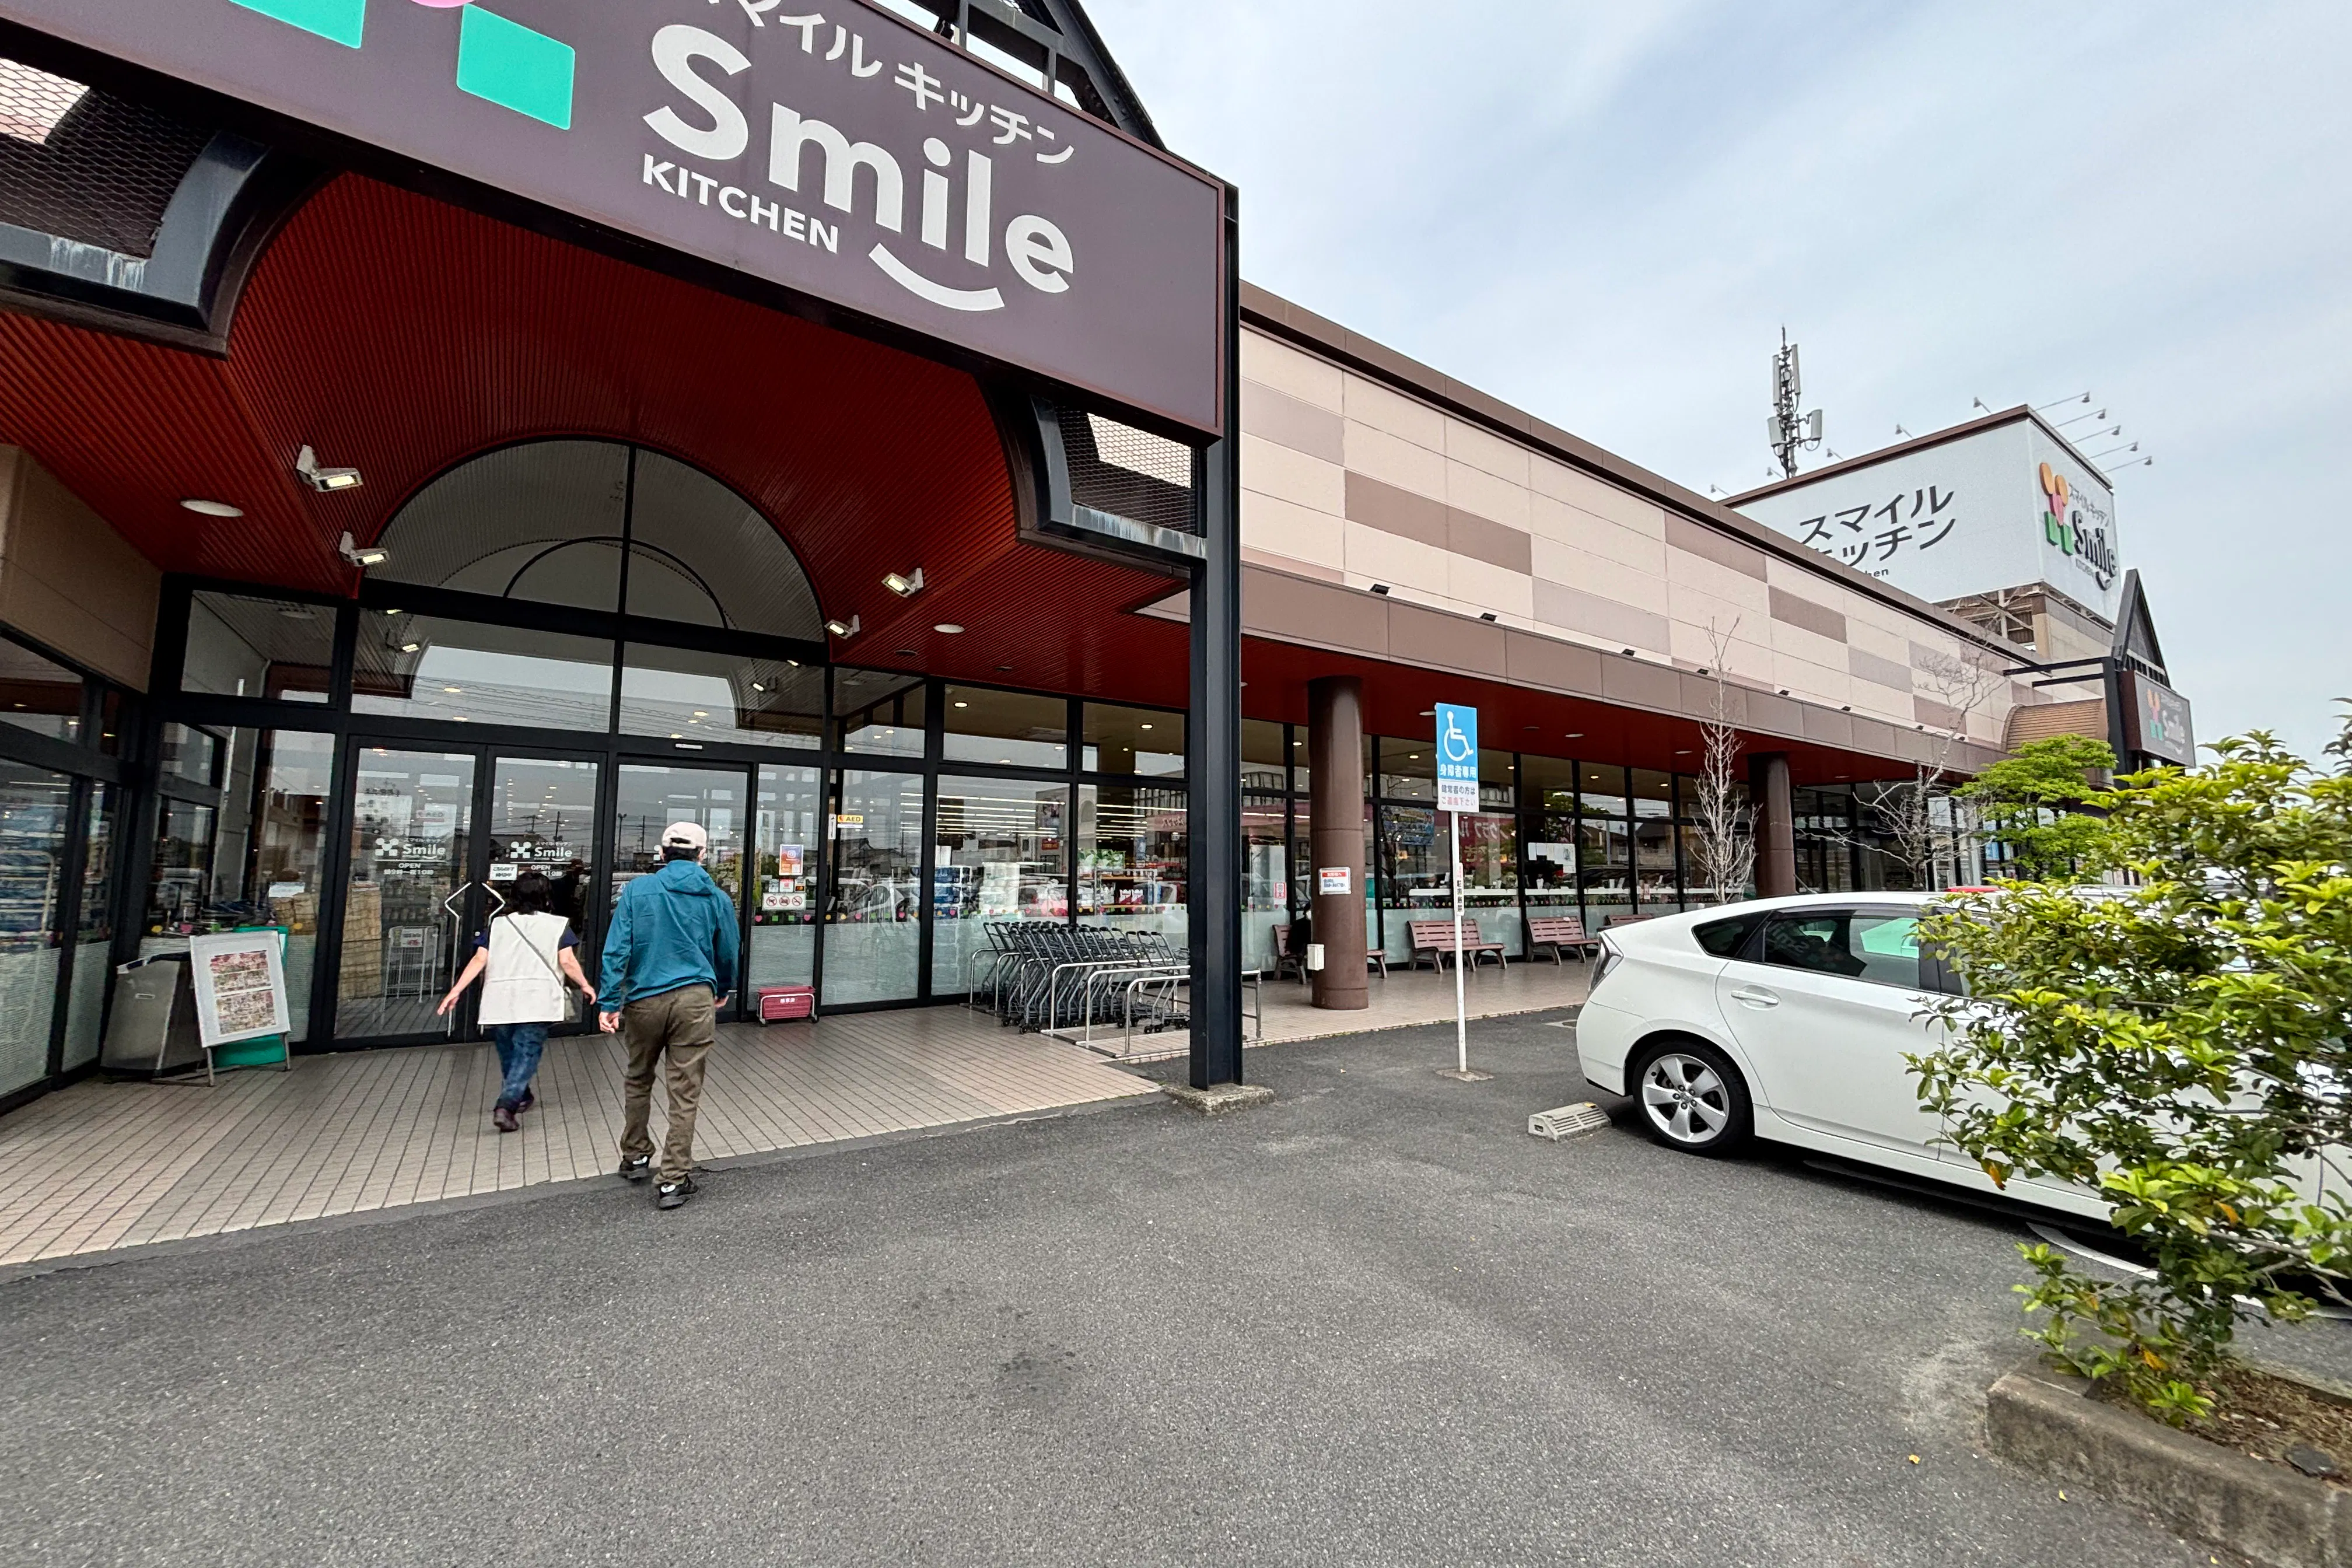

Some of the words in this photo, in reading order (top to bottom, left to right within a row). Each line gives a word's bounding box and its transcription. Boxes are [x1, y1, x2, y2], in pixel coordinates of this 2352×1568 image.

[708, 0, 883, 78] マイル
[642, 24, 1074, 293] Smile
[643, 153, 838, 254] KITCHEN
[1800, 485, 1955, 545] スマイル
[1814, 519, 1957, 567] ッチン
[2072, 510, 2117, 578] Smile
[402, 844, 446, 855] Smile
[534, 846, 573, 858] Smile
